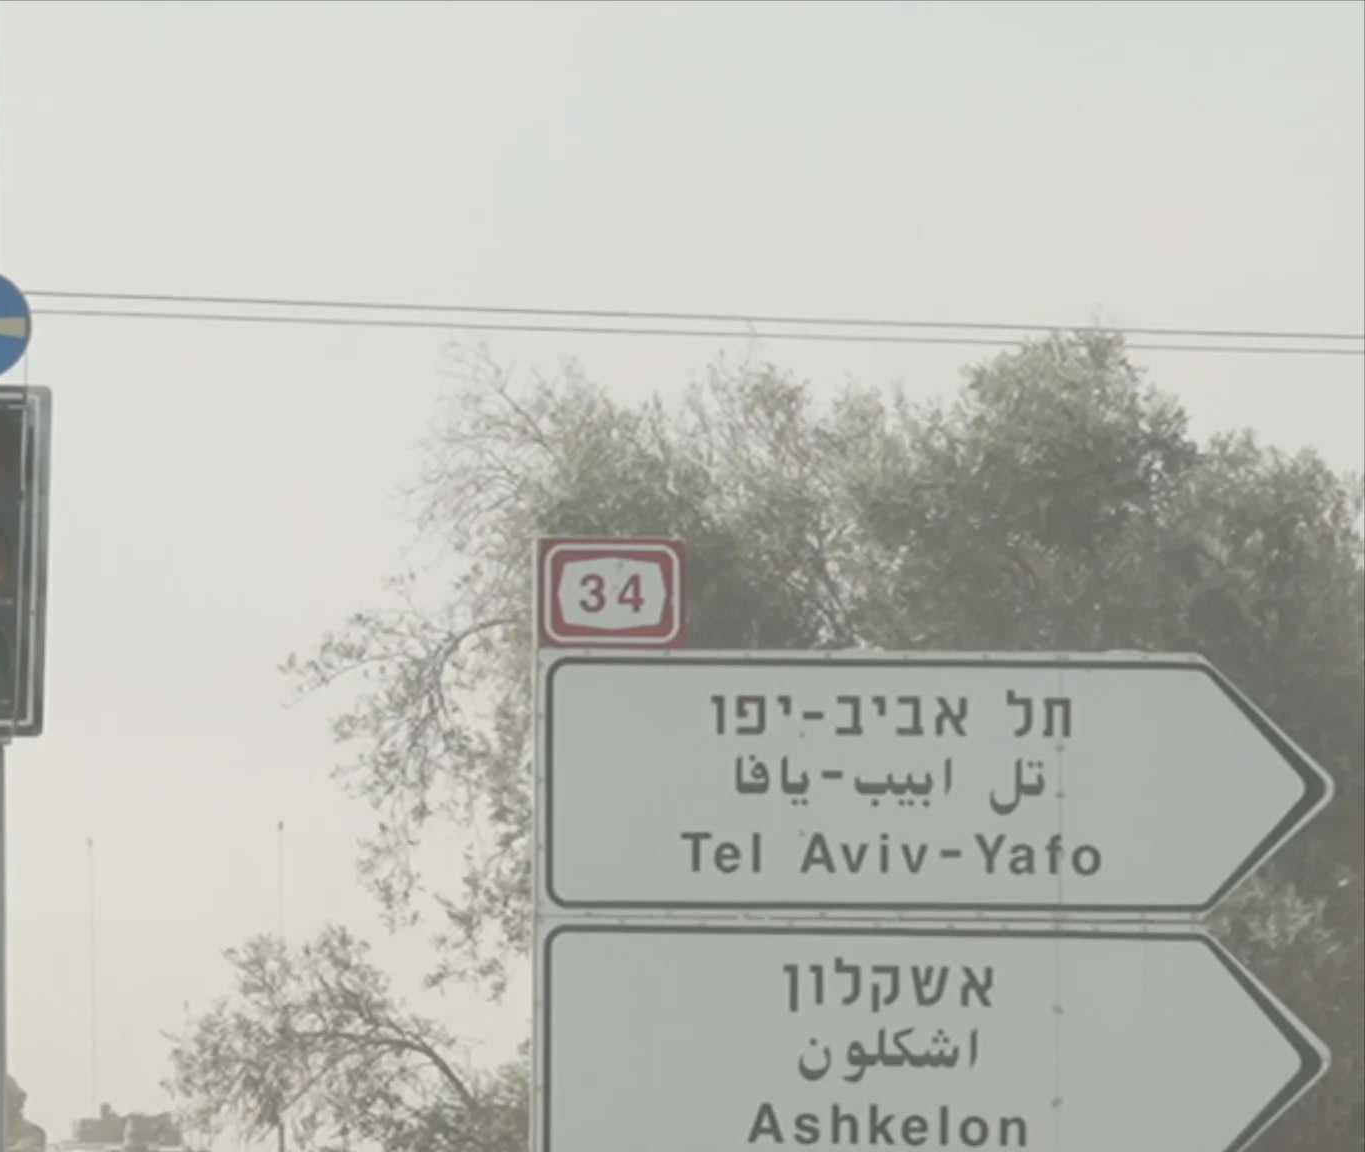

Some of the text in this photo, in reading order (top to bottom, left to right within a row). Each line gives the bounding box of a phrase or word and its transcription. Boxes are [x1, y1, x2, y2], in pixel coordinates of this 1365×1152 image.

[579, 573, 645, 614] 34
[710, 689, 1072, 738] תל אביב-יפו
[989, 758, 1046, 816] تل
[680, 831, 1102, 877] Tel Aviv-Yafo
[783, 956, 993, 1013] אשקלון
[798, 1027, 978, 1084] اشكلون
[747, 1102, 1027, 1148] Ashkelon
